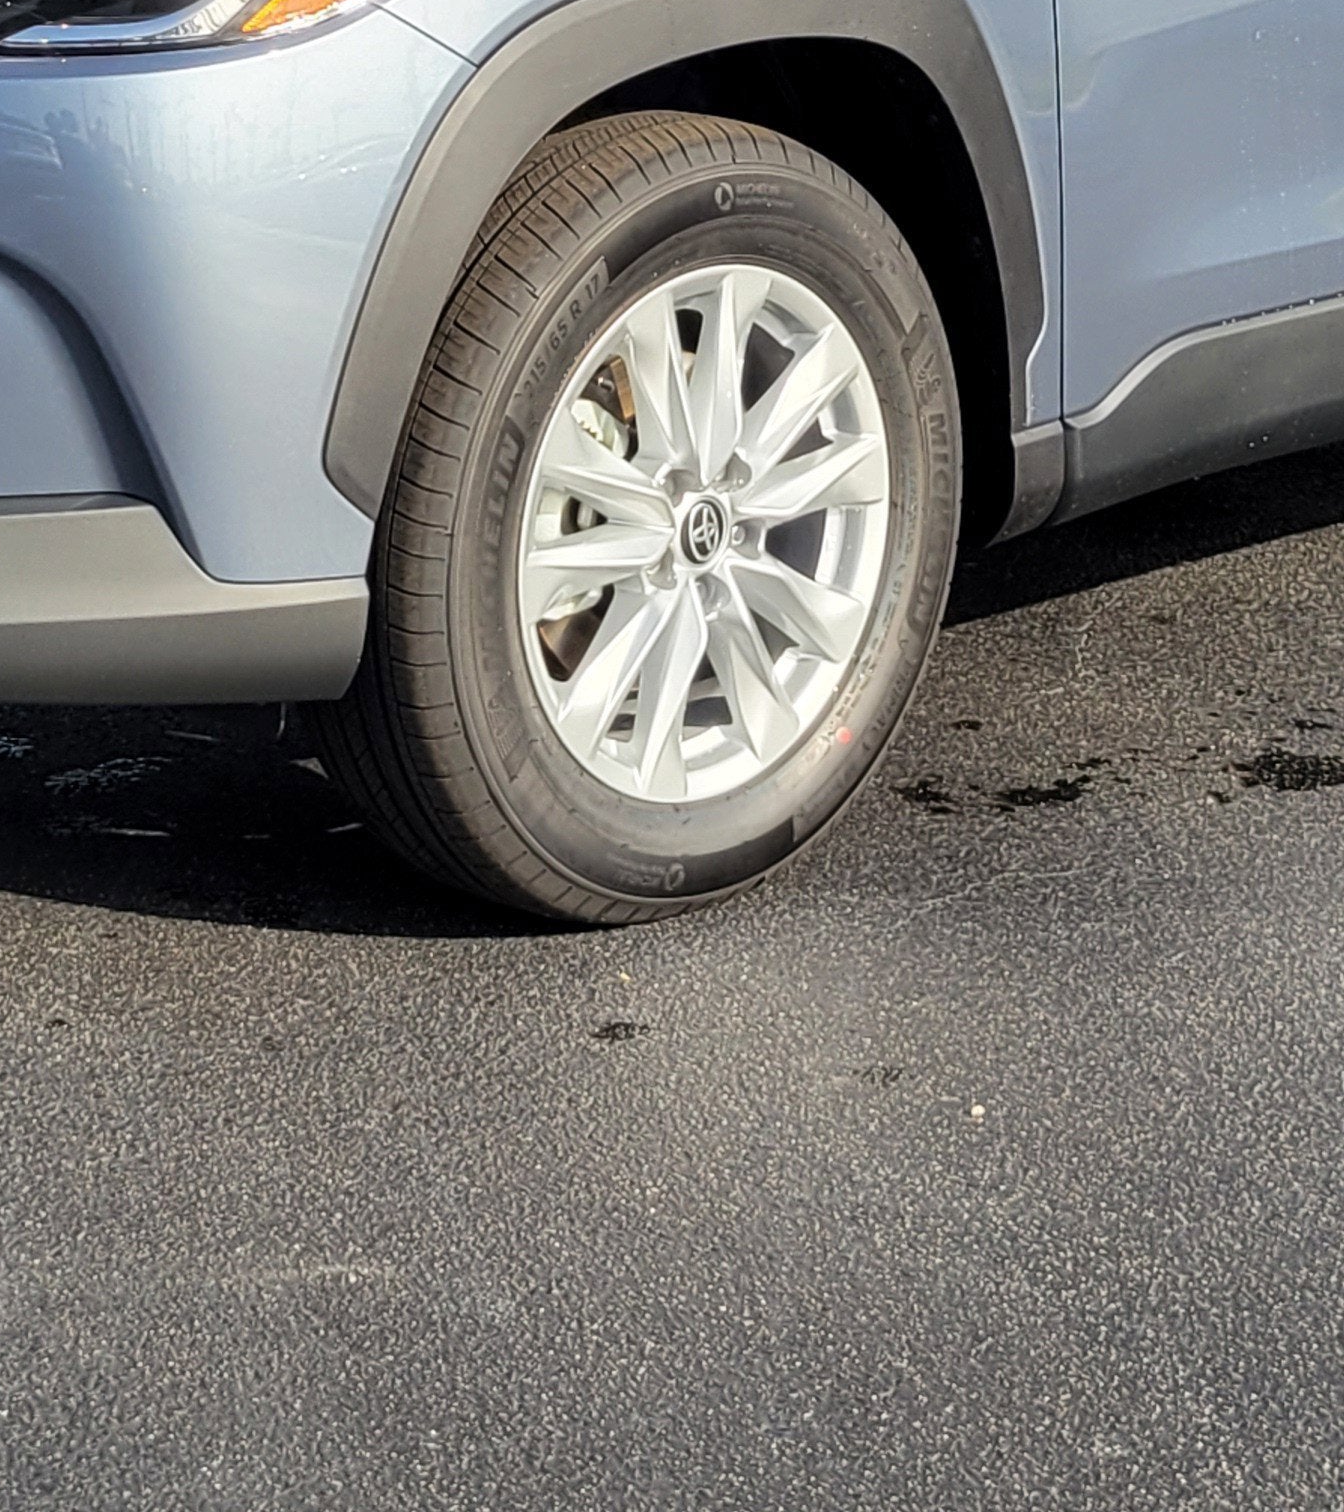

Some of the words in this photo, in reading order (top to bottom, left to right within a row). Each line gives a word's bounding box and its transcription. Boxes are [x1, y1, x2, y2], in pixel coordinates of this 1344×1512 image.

[585, 273, 600, 300] 17
[479, 430, 519, 676] CHELIN
[913, 412, 949, 624] MICLIN
